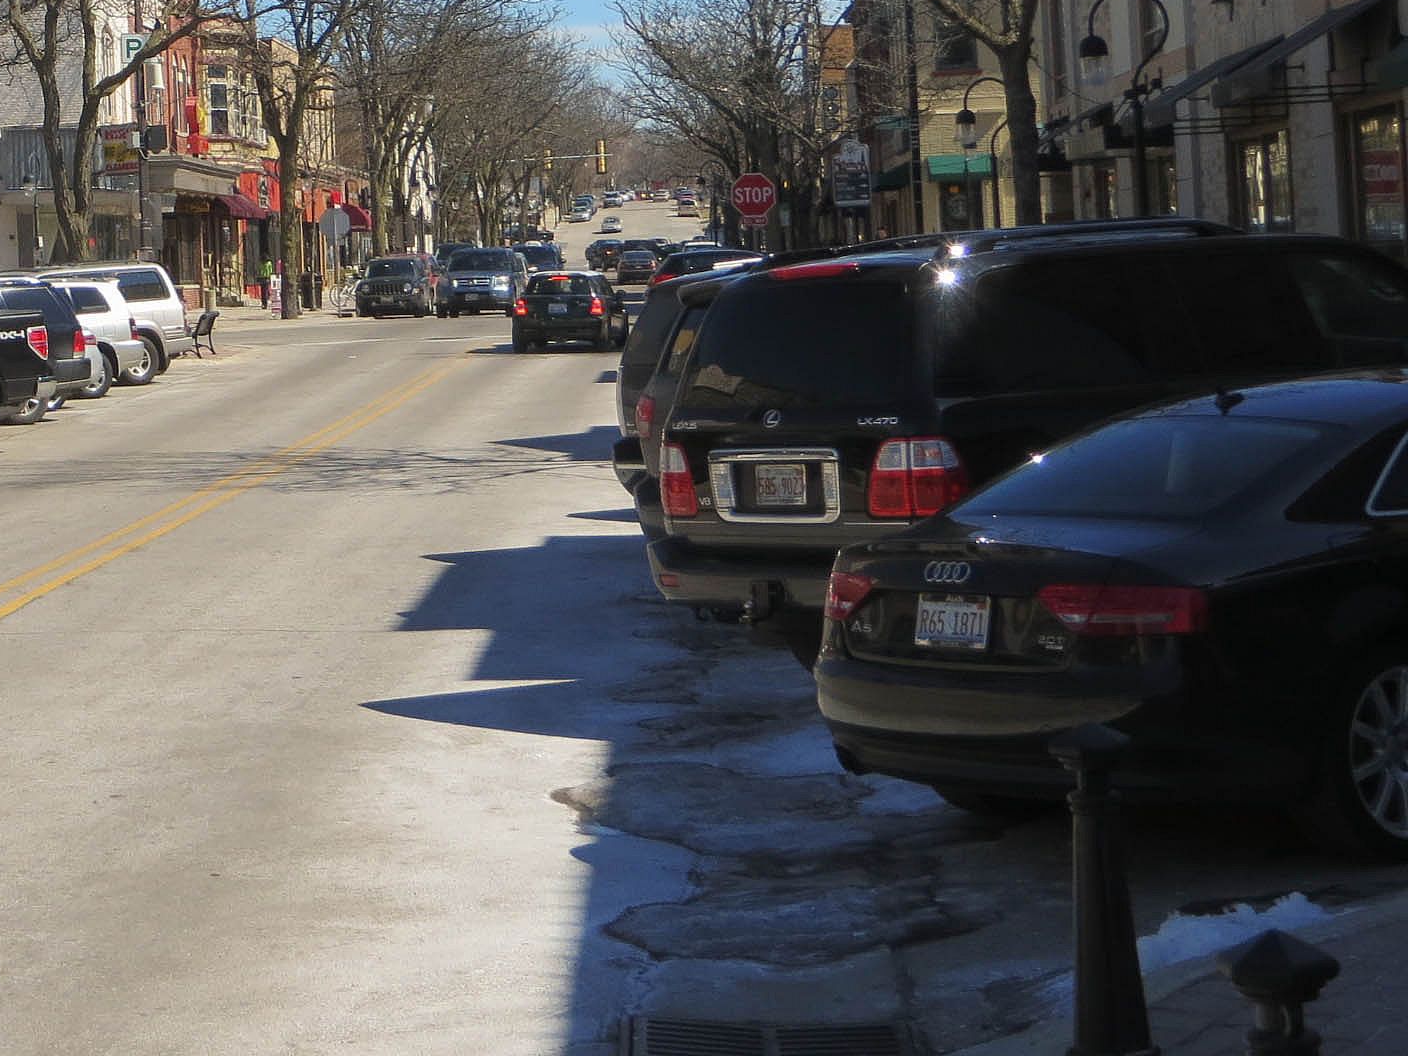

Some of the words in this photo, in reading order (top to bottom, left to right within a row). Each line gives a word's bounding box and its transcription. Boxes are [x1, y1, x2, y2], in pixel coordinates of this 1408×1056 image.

[126, 38, 142, 59] P
[735, 187, 772, 204] STOP
[699, 496, 712, 507] V8
[920, 609, 946, 633] R65
[952, 612, 985, 638] 1871
